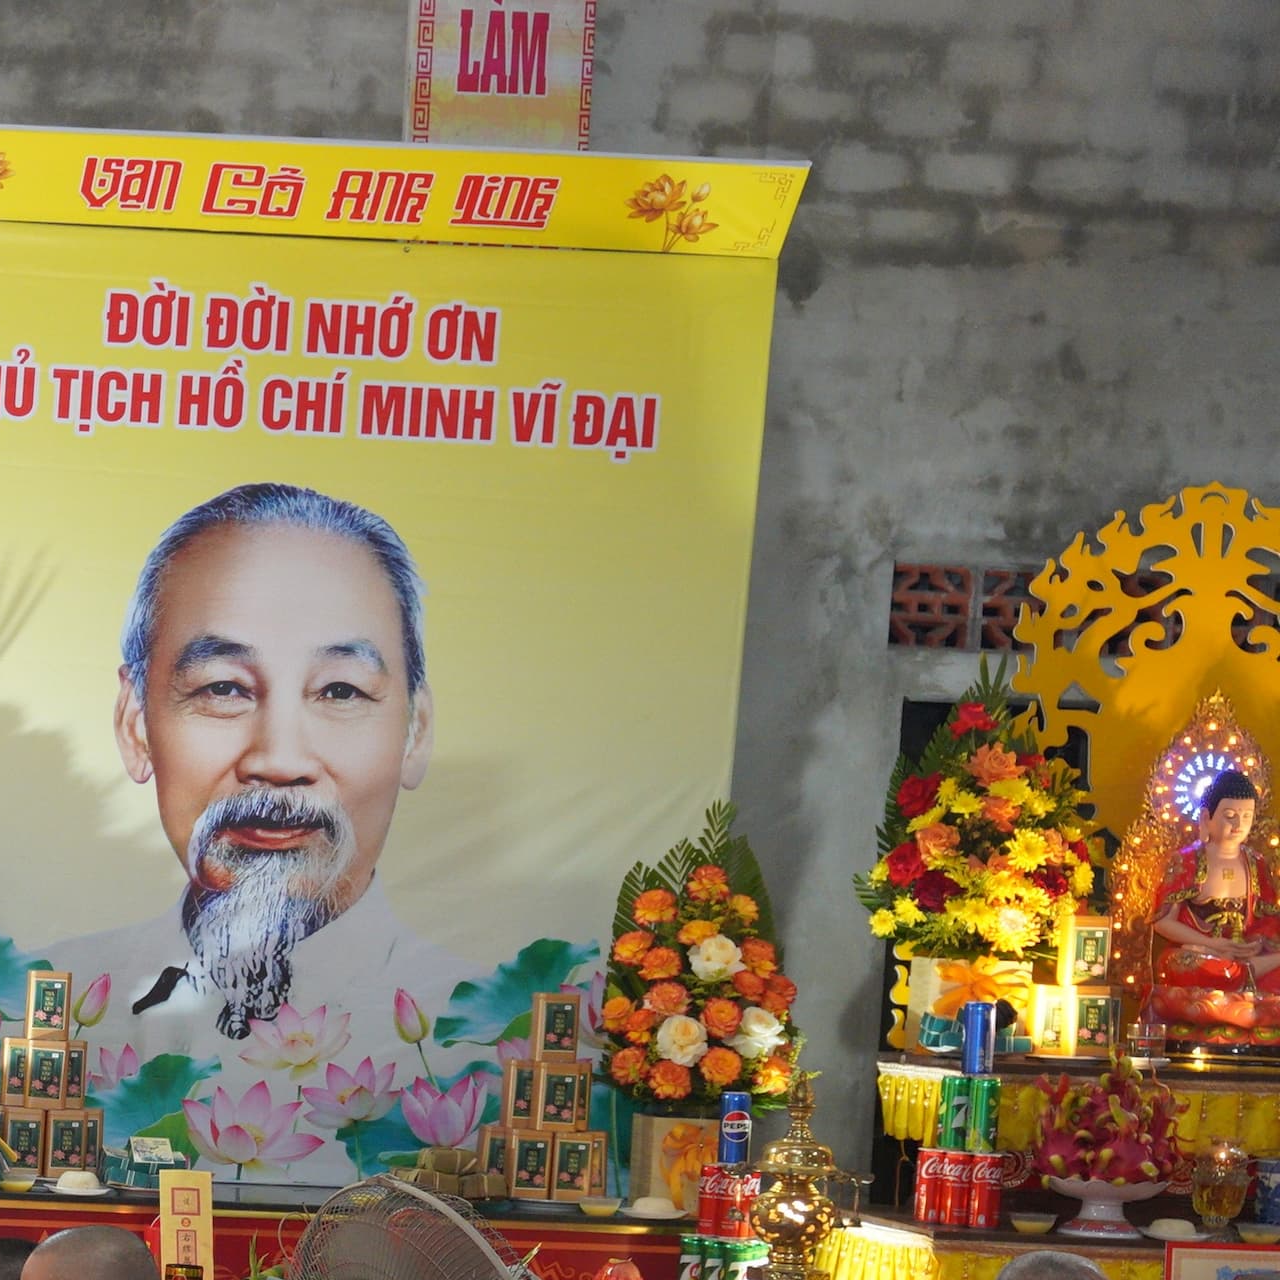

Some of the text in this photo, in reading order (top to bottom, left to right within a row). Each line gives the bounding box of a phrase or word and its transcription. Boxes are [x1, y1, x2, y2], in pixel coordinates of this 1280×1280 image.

[106, 282, 498, 363] ĐỜI ĐỜI NHỚ ƠN
[52, 368, 164, 432] TỊCH
[178, 360, 246, 429] HỒ
[260, 372, 347, 434] CHÍ
[361, 385, 496, 441] MINH
[512, 382, 562, 444] VĨ
[572, 396, 659, 460] ĐẠI
